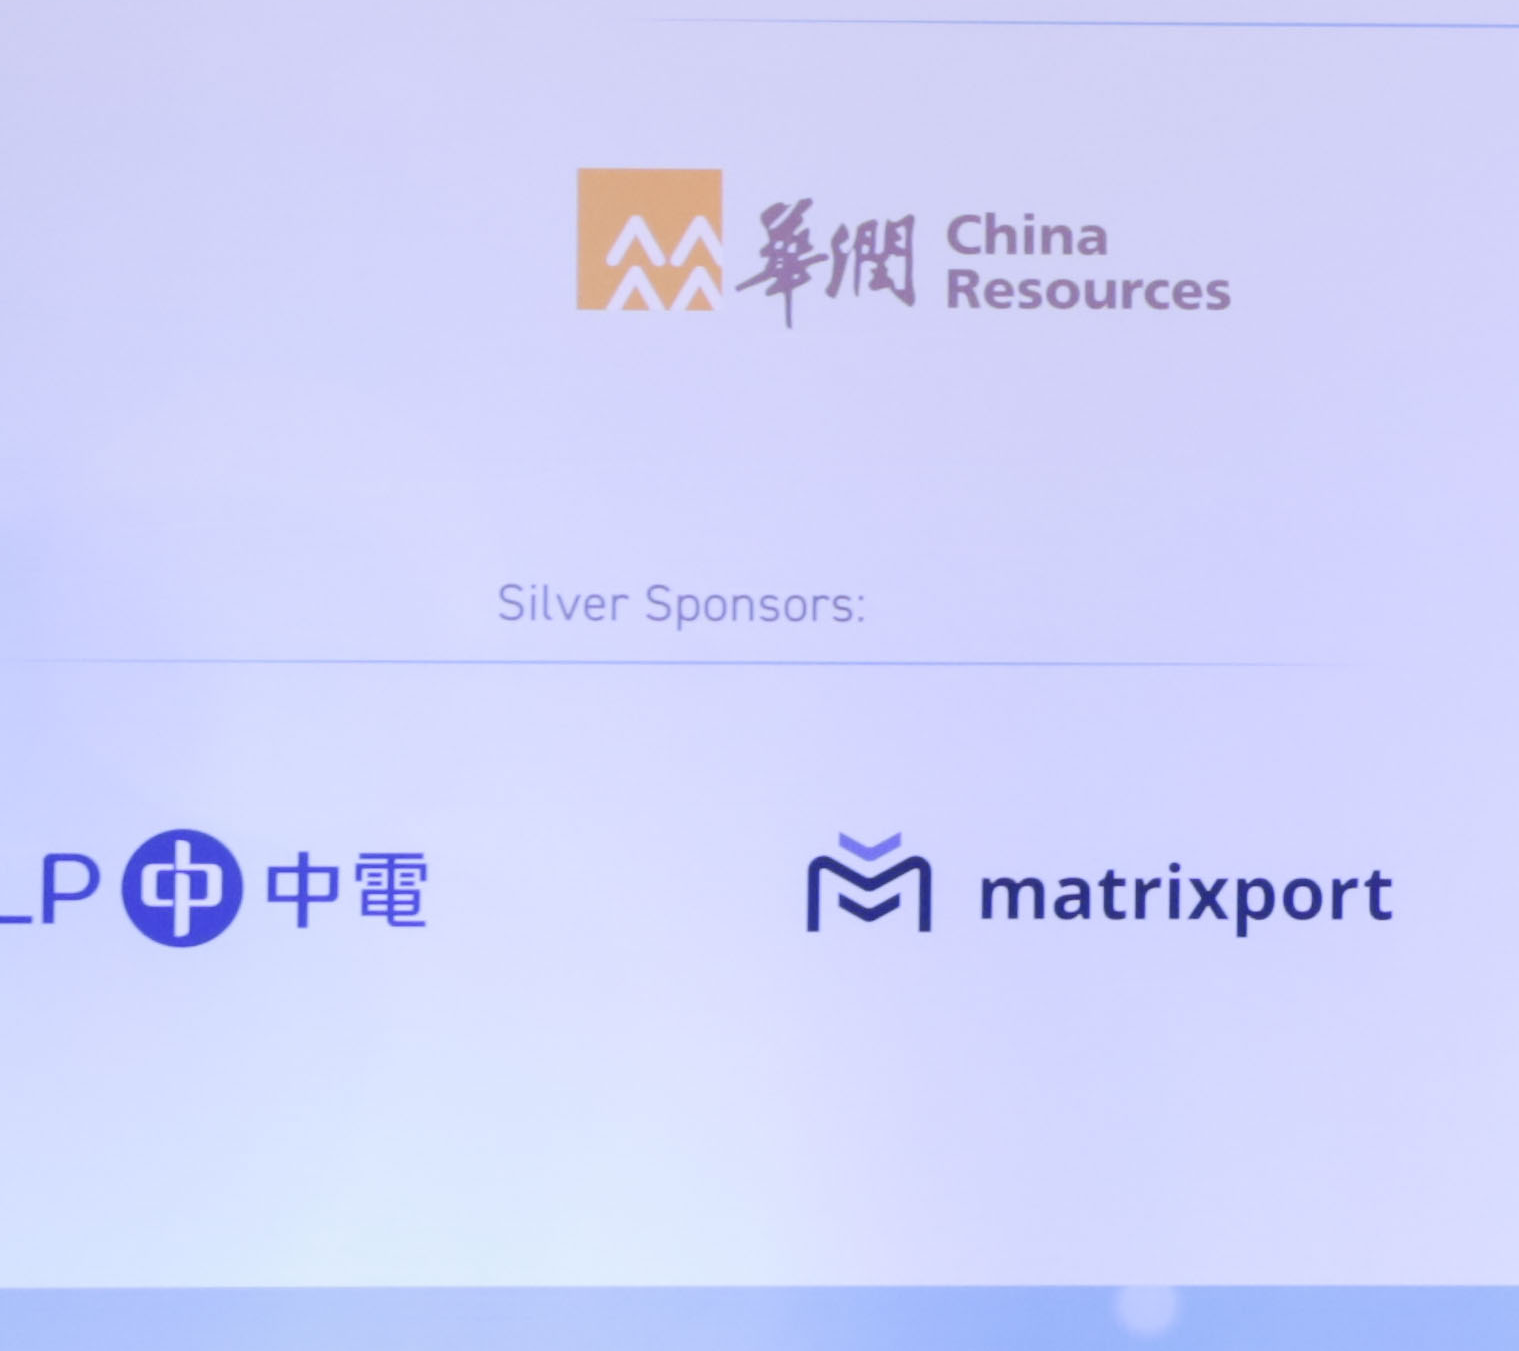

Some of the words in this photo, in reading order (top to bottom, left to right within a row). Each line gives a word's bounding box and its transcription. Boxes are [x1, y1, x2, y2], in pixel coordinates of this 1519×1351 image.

[947, 212, 1107, 255] China
[948, 269, 1230, 310] Resources
[499, 583, 629, 621] Silver
[646, 584, 864, 631] Sponsors:
[267, 851, 427, 928] 中電
[982, 862, 1392, 938] matrixport
